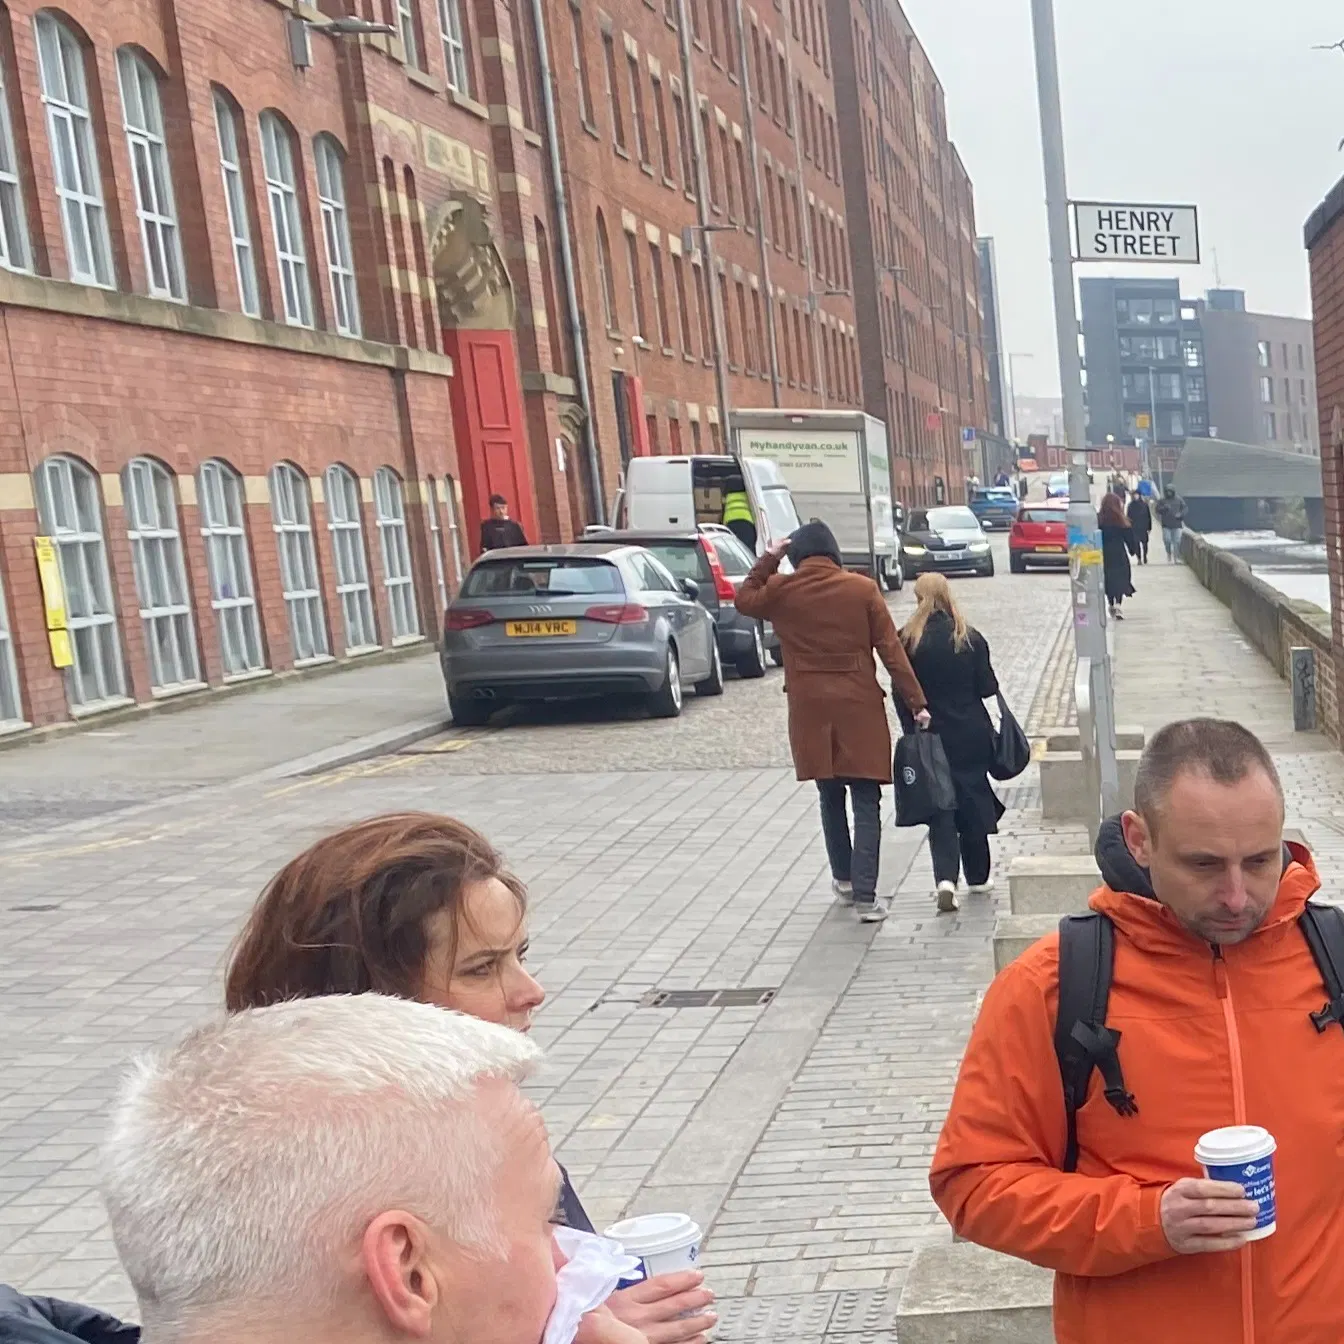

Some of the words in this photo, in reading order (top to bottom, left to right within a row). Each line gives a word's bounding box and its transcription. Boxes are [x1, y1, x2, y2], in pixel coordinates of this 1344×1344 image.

[1097, 210, 1174, 232] HENRY
[1094, 233, 1180, 256] STREET
[750, 440, 848, 452] Myhandyvan.co.uk
